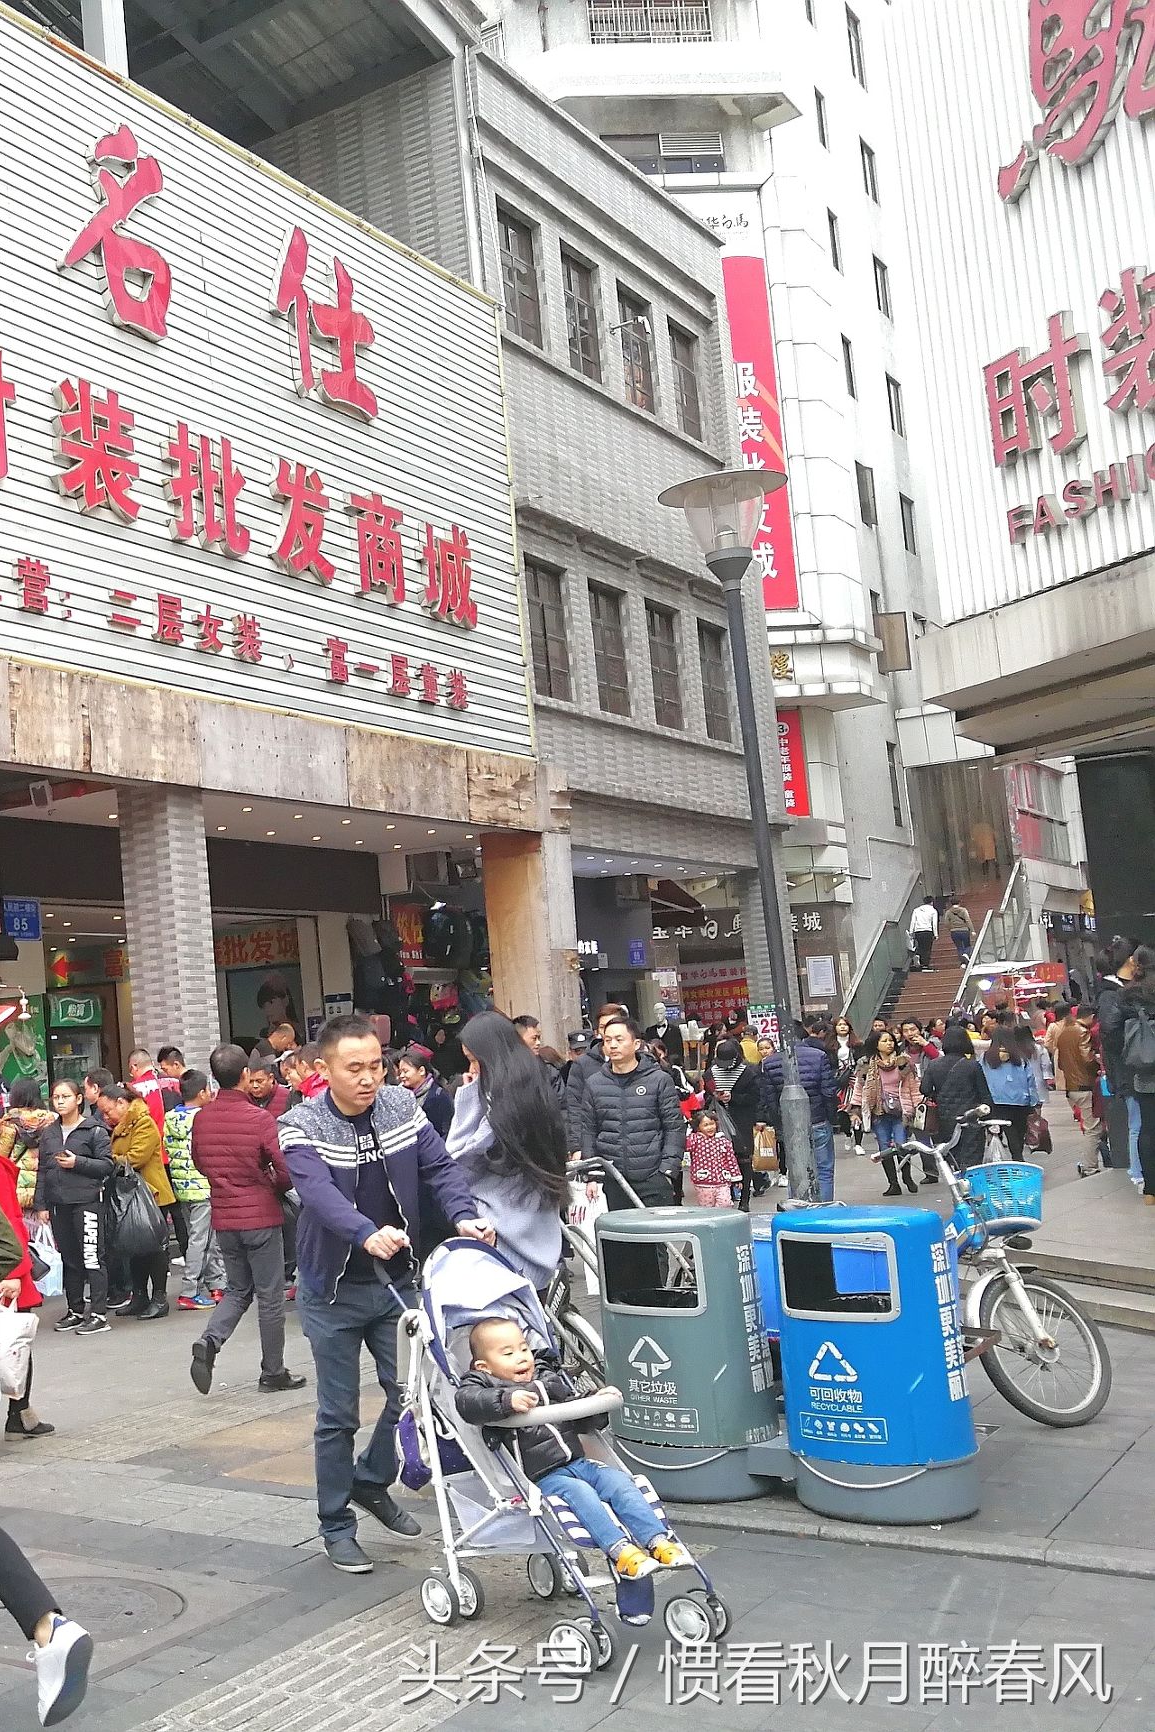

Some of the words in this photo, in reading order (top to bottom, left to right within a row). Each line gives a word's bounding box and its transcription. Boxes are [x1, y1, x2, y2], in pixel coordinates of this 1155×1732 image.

[733, 362, 778, 579] 服装城
[1006, 442, 1155, 546] FASHI
[14, 917, 28, 931] 85
[760, 1018, 779, 1034] 25
[628, 1378, 678, 1396] 其它垃圾
[808, 1386, 863, 1405] 可回收物
[653, 1396, 678, 1405] WASTE
[810, 1402, 864, 1414] RECYCLABLE
